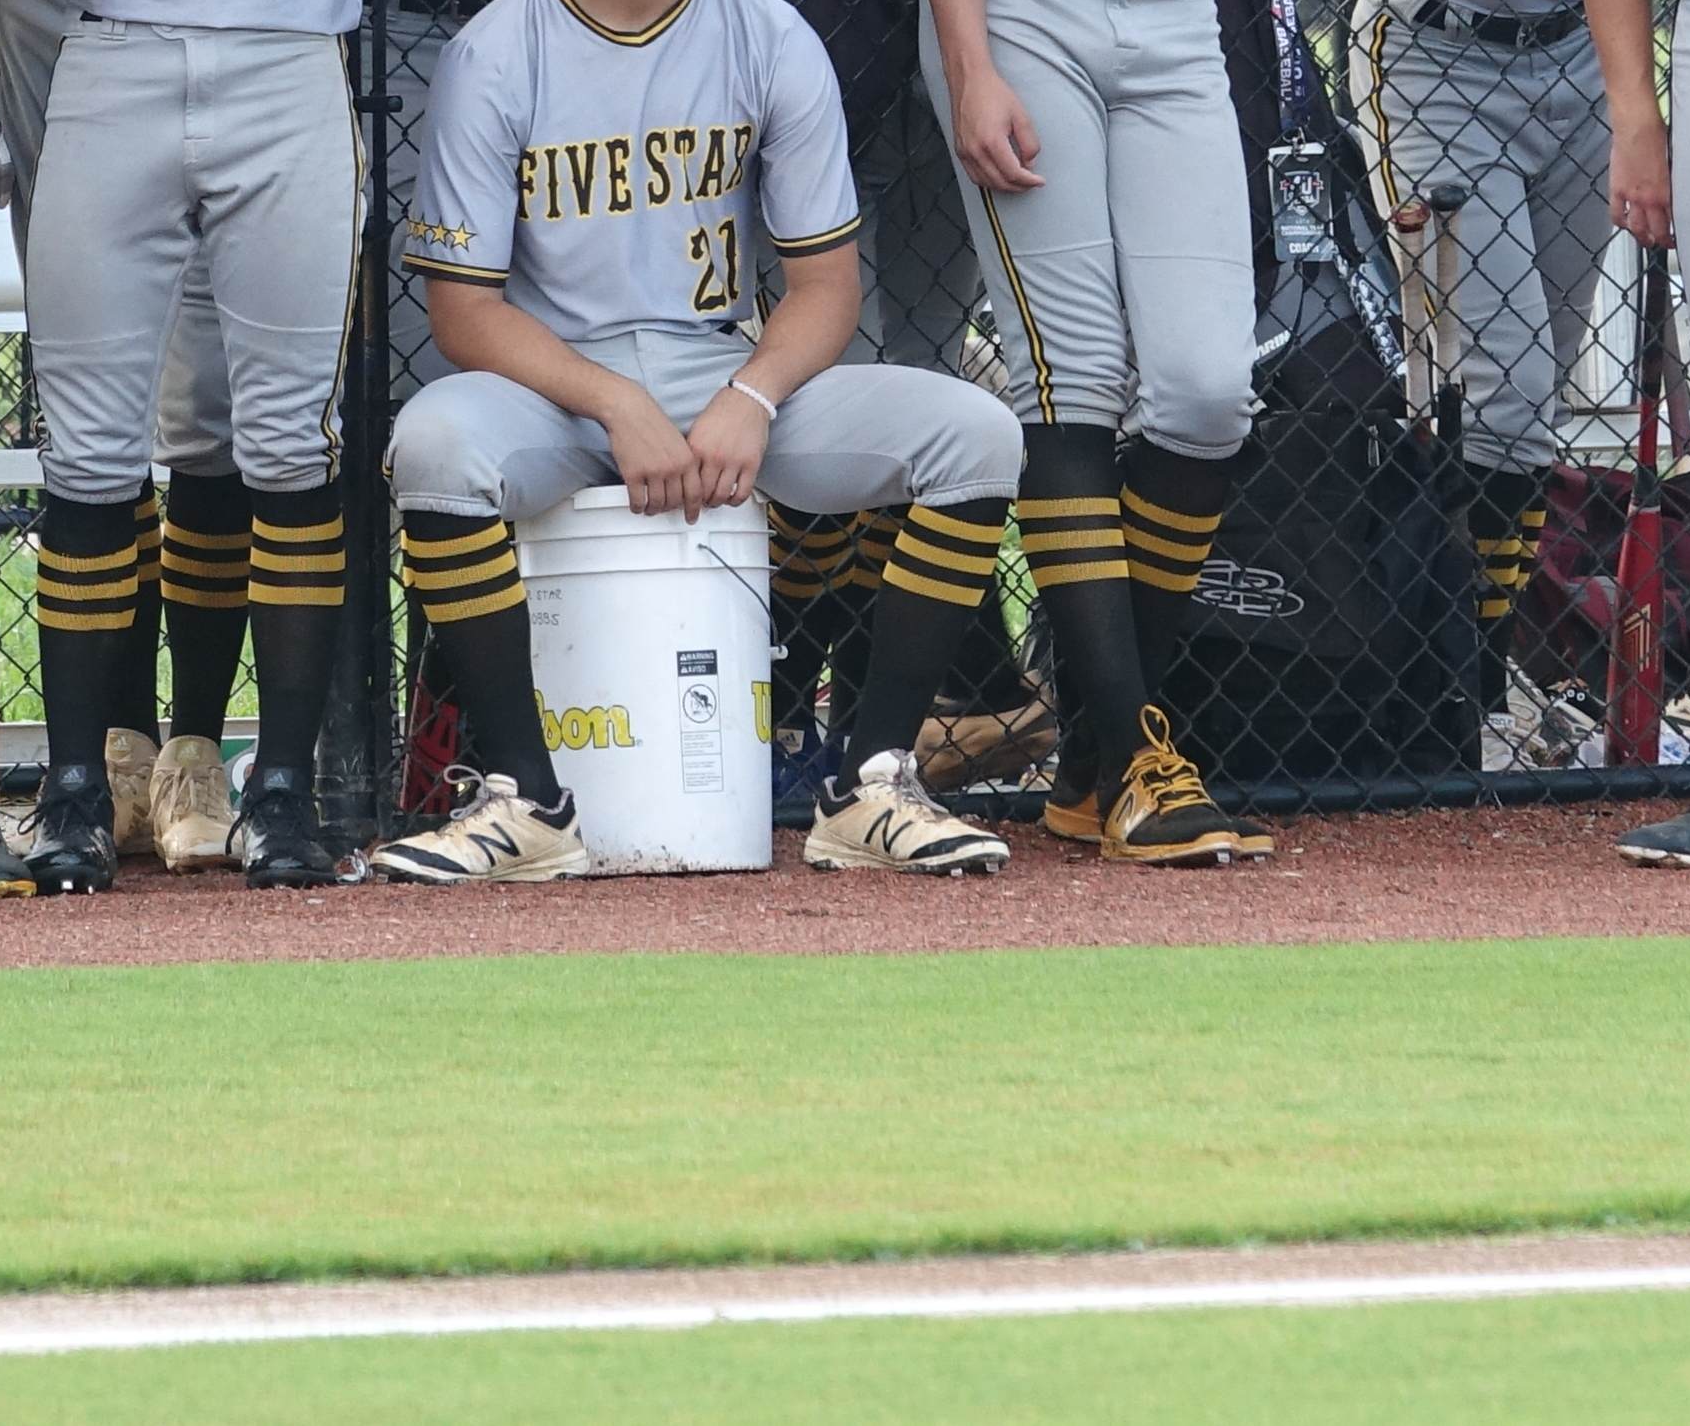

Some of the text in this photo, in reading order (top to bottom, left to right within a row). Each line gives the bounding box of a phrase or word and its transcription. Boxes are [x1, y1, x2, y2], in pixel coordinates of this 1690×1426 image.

[517, 123, 754, 222] FIVE STAR
[687, 215, 741, 316] 21
